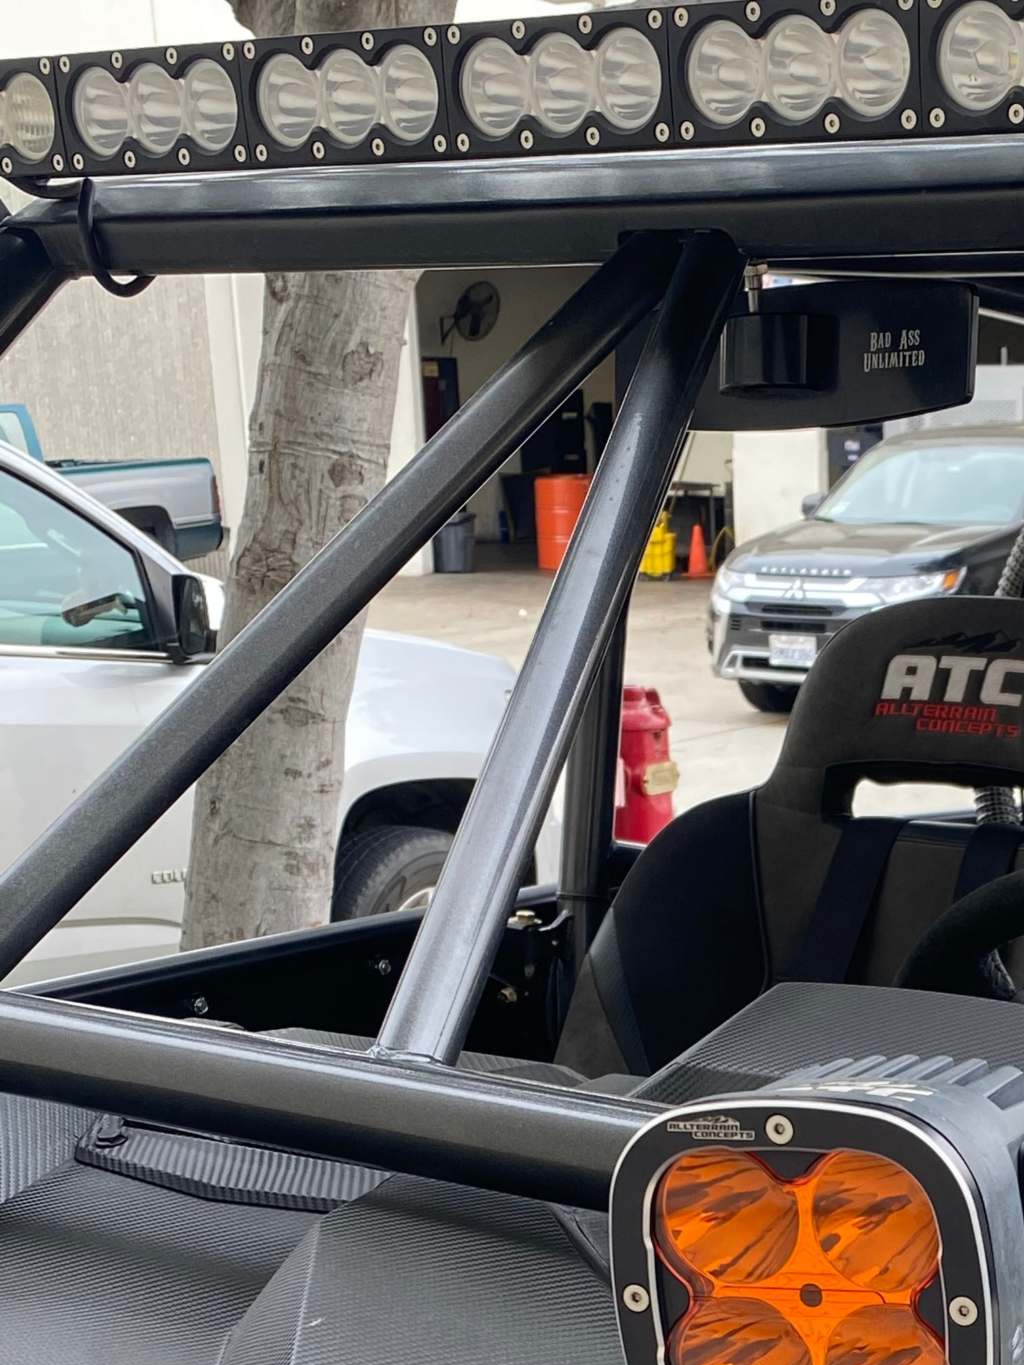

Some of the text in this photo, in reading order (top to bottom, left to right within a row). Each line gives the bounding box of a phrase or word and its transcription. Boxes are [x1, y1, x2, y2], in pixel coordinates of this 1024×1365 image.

[863, 350, 925, 373] UNLIMITED
[874, 702, 998, 722] ALLTERRAIN
[915, 717, 1021, 739] CONCEPTS
[668, 1122, 739, 1131] ALLTERRAIN
[694, 1130, 753, 1139] CONCEPTS
